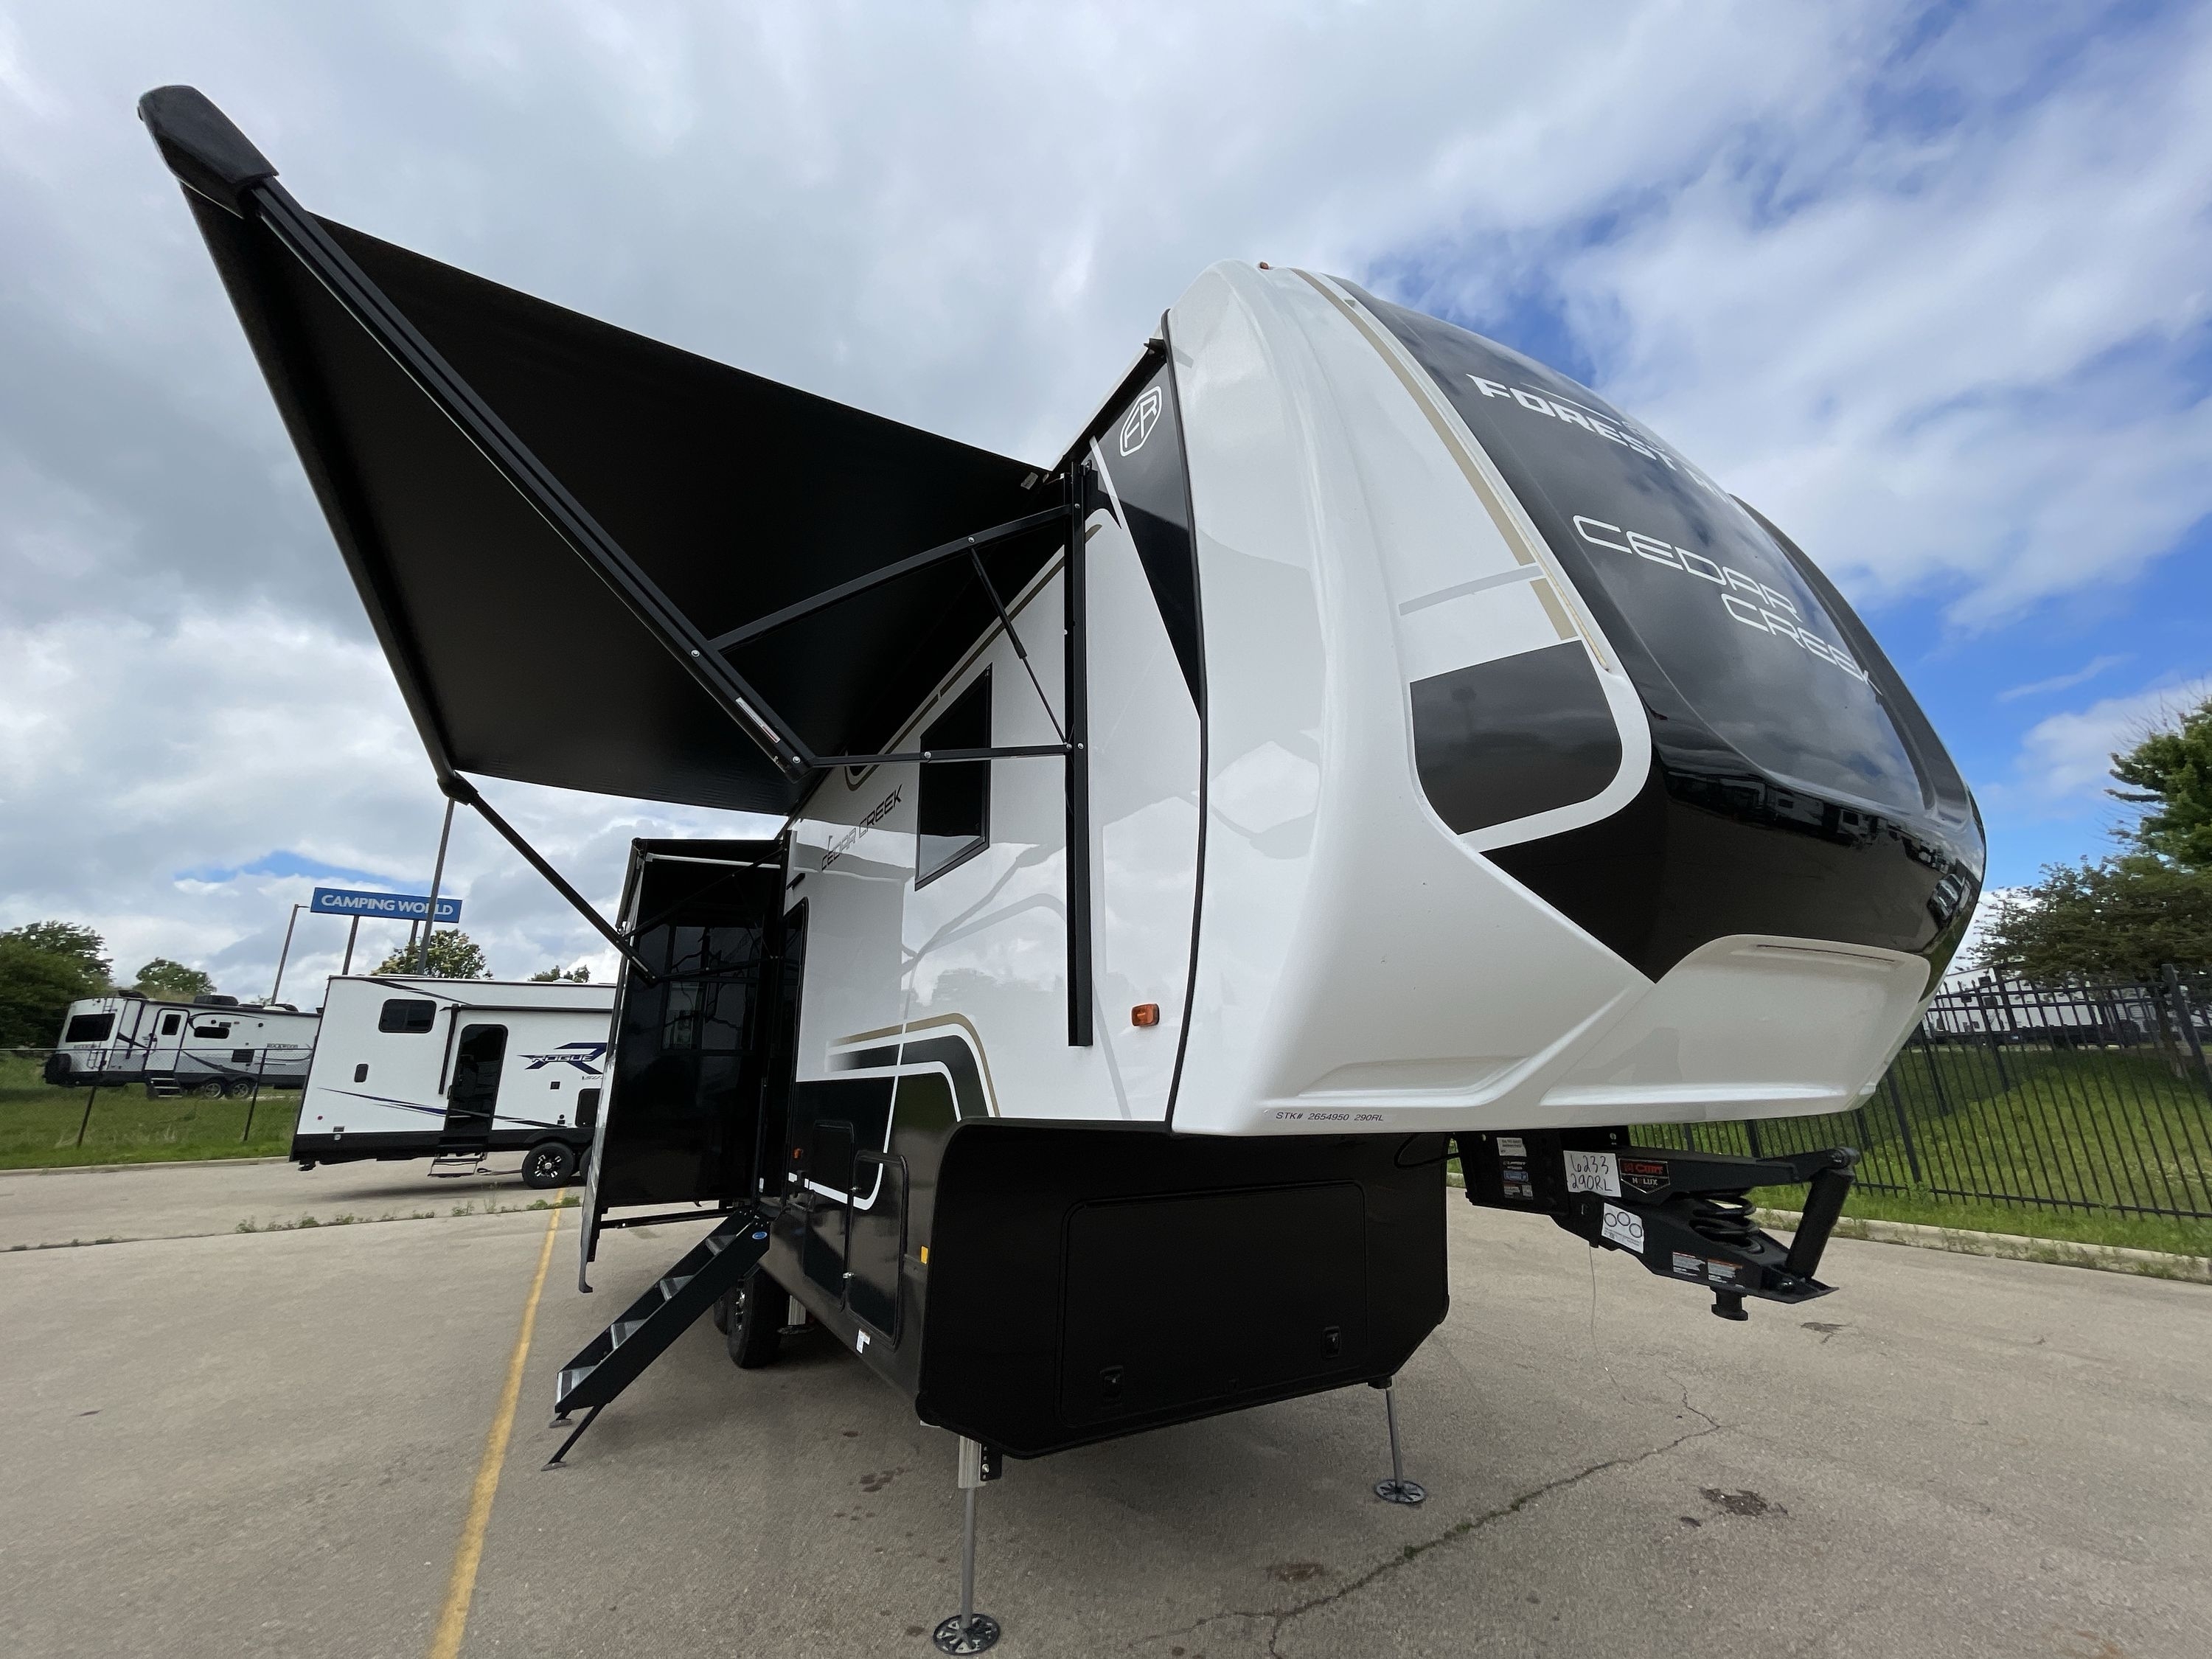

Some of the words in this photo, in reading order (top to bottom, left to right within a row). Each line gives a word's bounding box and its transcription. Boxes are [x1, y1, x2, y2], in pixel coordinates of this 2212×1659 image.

[1466, 373, 1677, 470] FOREST
[1573, 515, 1803, 622] CEDAR
[1721, 593, 1882, 696] CREEK
[821, 827, 856, 871] CEDAR
[859, 783, 902, 838] CREEK
[321, 894, 395, 911] CAMPING
[531, 1054, 594, 1063] ROGUE
[1276, 1111, 1304, 1119] STK#
[1307, 1113, 1349, 1121] 2654950
[1570, 1154, 1609, 1175] 6233
[1571, 1173, 1613, 1192] 290RL
